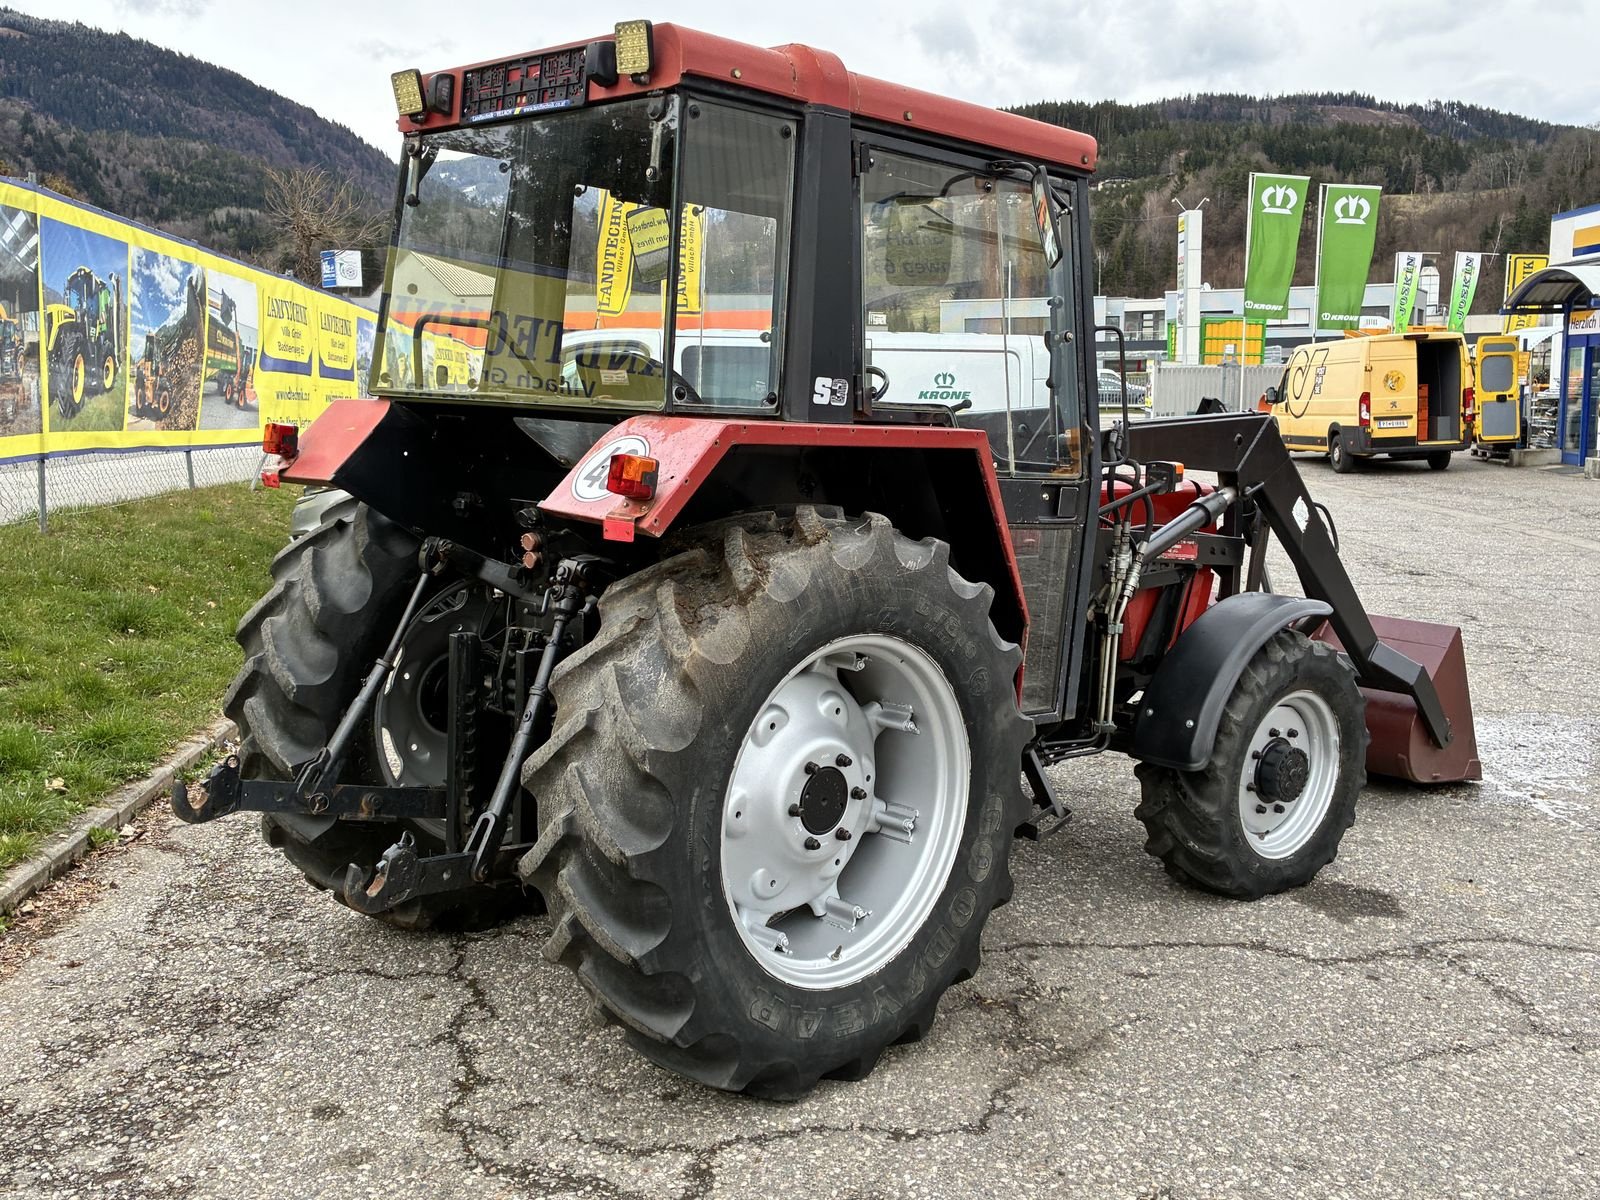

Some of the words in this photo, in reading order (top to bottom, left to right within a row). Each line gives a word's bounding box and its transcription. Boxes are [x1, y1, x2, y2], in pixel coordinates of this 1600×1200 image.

[599, 198, 624, 308] LANDTECHN
[1399, 255, 1416, 317] JOSKIN
[1456, 256, 1475, 320] JOSKIN
[1570, 315, 1597, 330] Herzlich
[918, 390, 971, 400] KRONE
[748, 793, 1004, 1040] GOODYEAR
